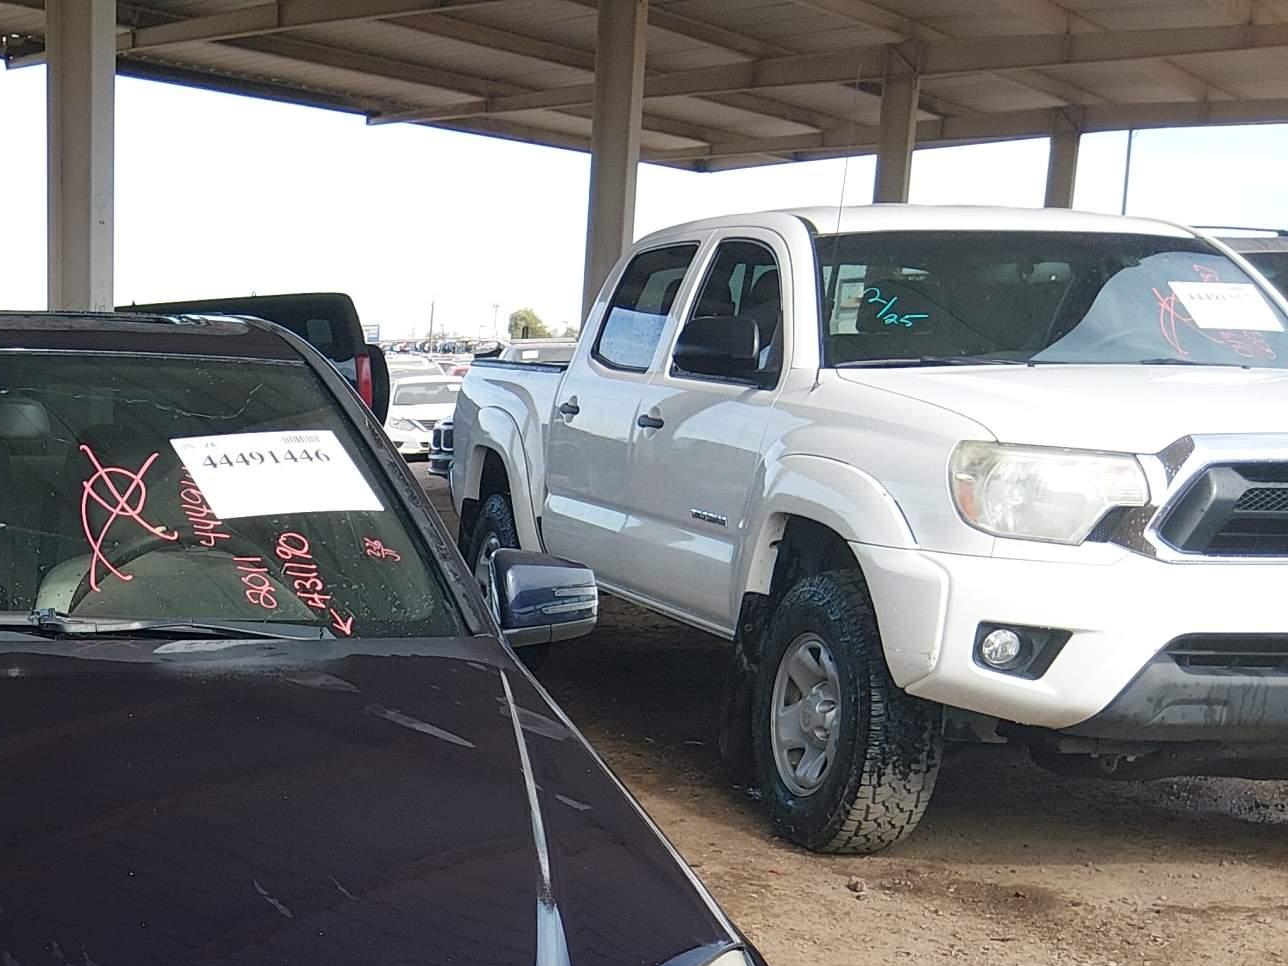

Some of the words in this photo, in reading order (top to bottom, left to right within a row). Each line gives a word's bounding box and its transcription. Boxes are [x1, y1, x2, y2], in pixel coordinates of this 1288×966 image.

[863, 287, 929, 328] 2/25
[202, 448, 331, 468] 44491446
[231, 556, 279, 610] 2011
